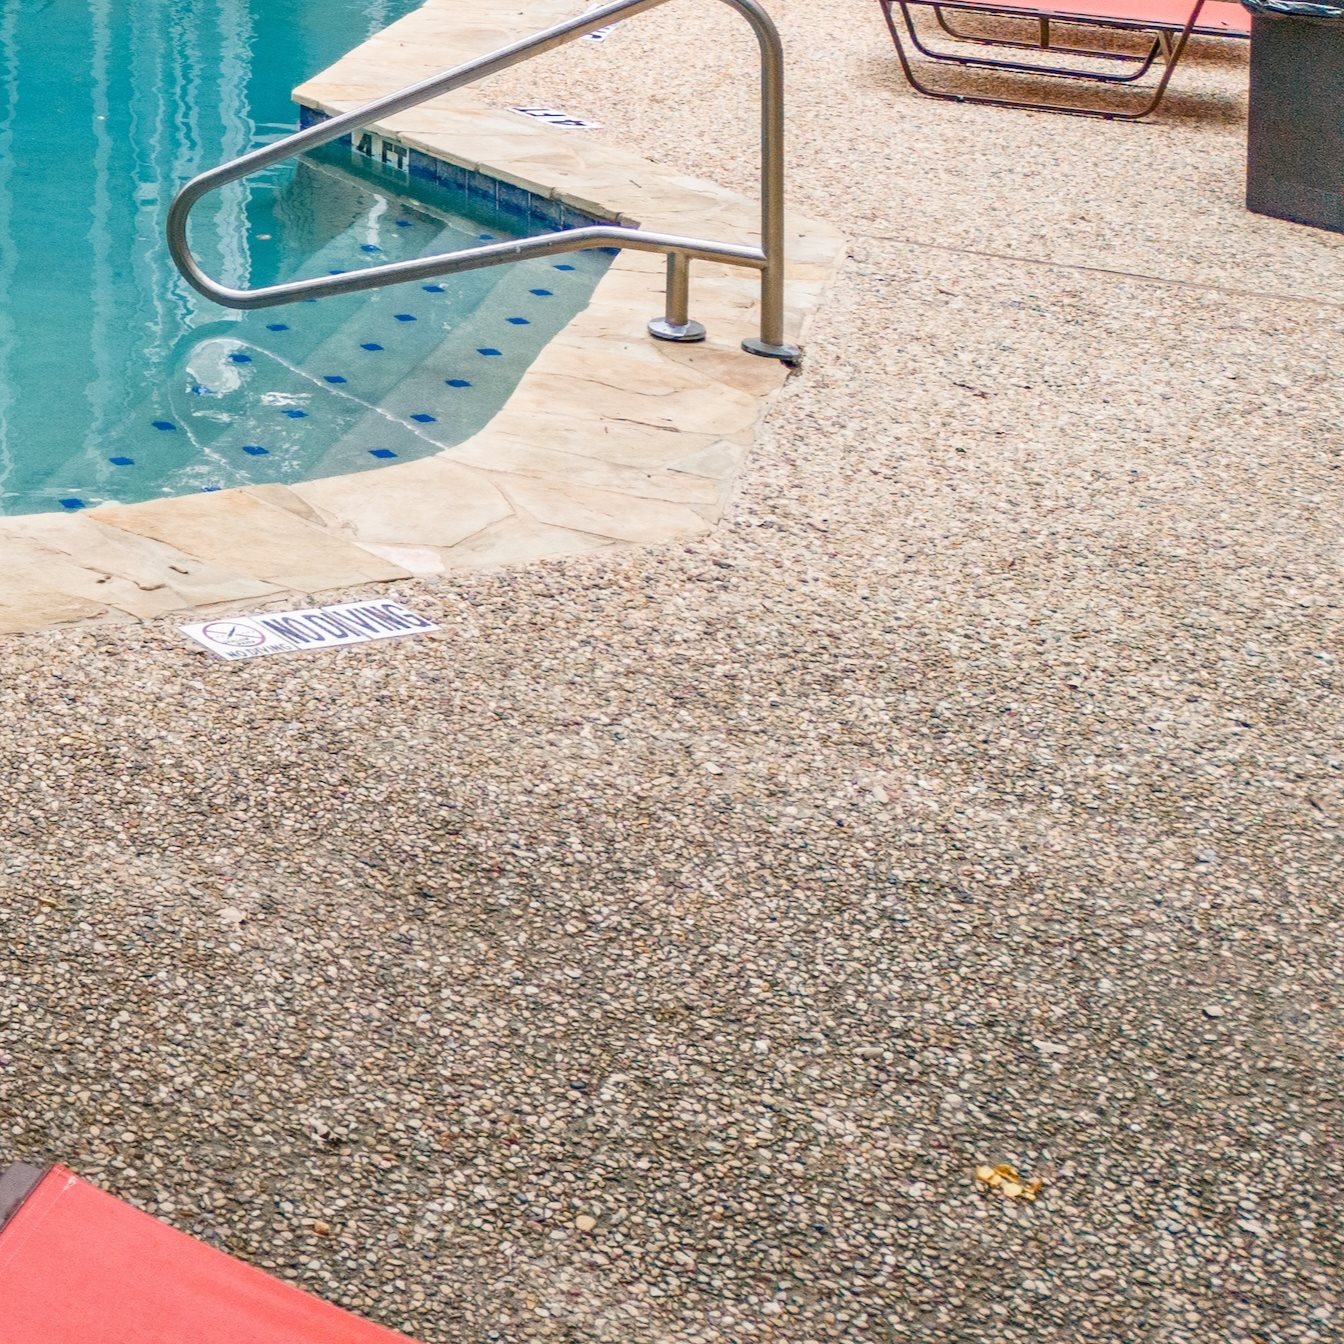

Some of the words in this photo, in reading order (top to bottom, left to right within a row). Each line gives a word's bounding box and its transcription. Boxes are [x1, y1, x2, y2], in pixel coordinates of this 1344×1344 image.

[357, 133, 375, 158] 4
[382, 139, 408, 170] FT
[263, 618, 325, 644] NO
[301, 604, 432, 639] DIVING
[226, 650, 247, 658] NO
[247, 643, 293, 655] DIVING
